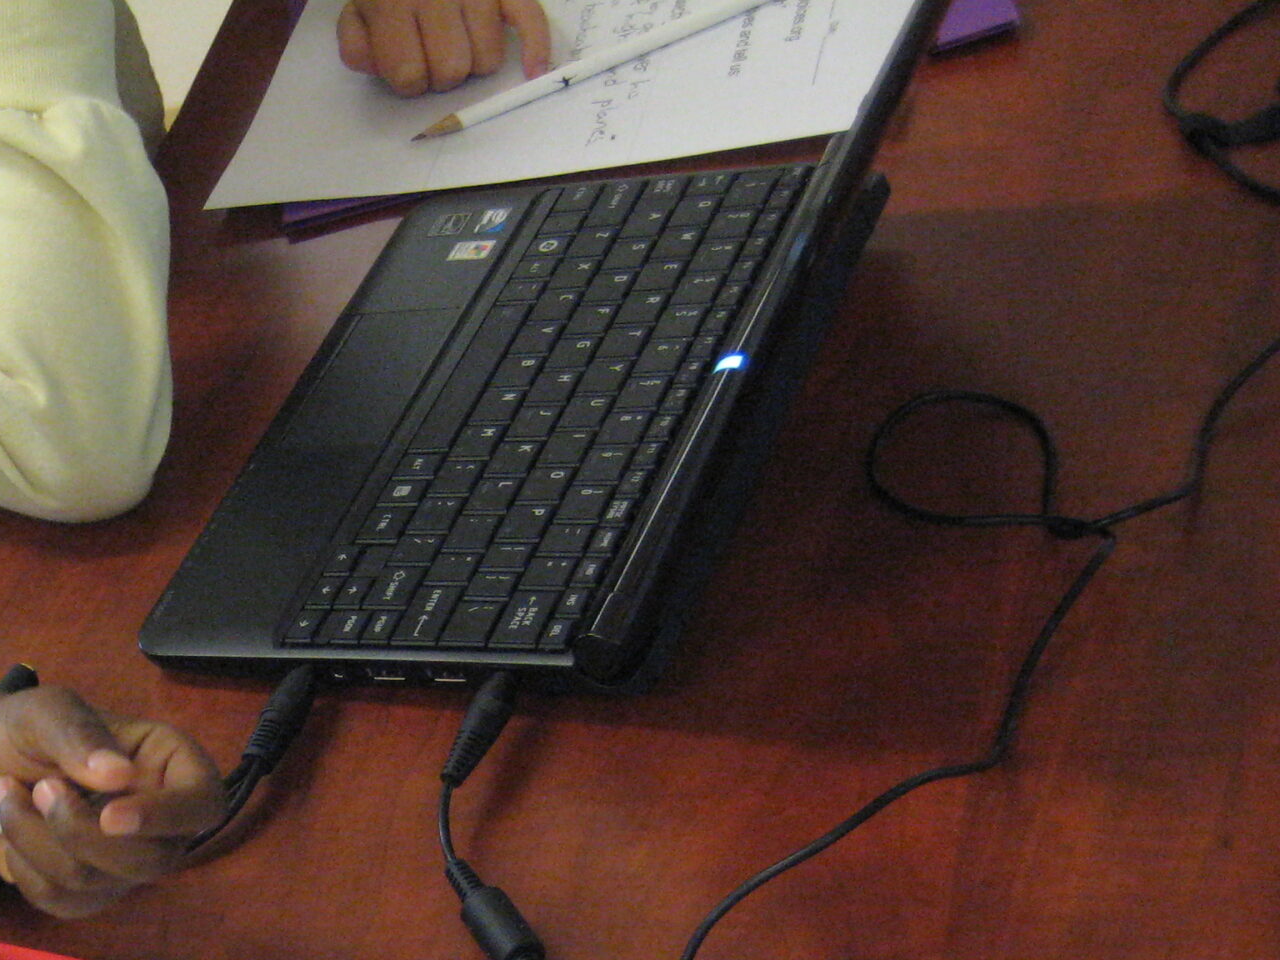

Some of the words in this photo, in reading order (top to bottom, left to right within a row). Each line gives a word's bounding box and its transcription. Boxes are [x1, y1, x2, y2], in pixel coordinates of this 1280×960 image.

[424, 589, 441, 610] ENTER
[508, 607, 526, 628] SPACE
[521, 607, 538, 625] BACK
